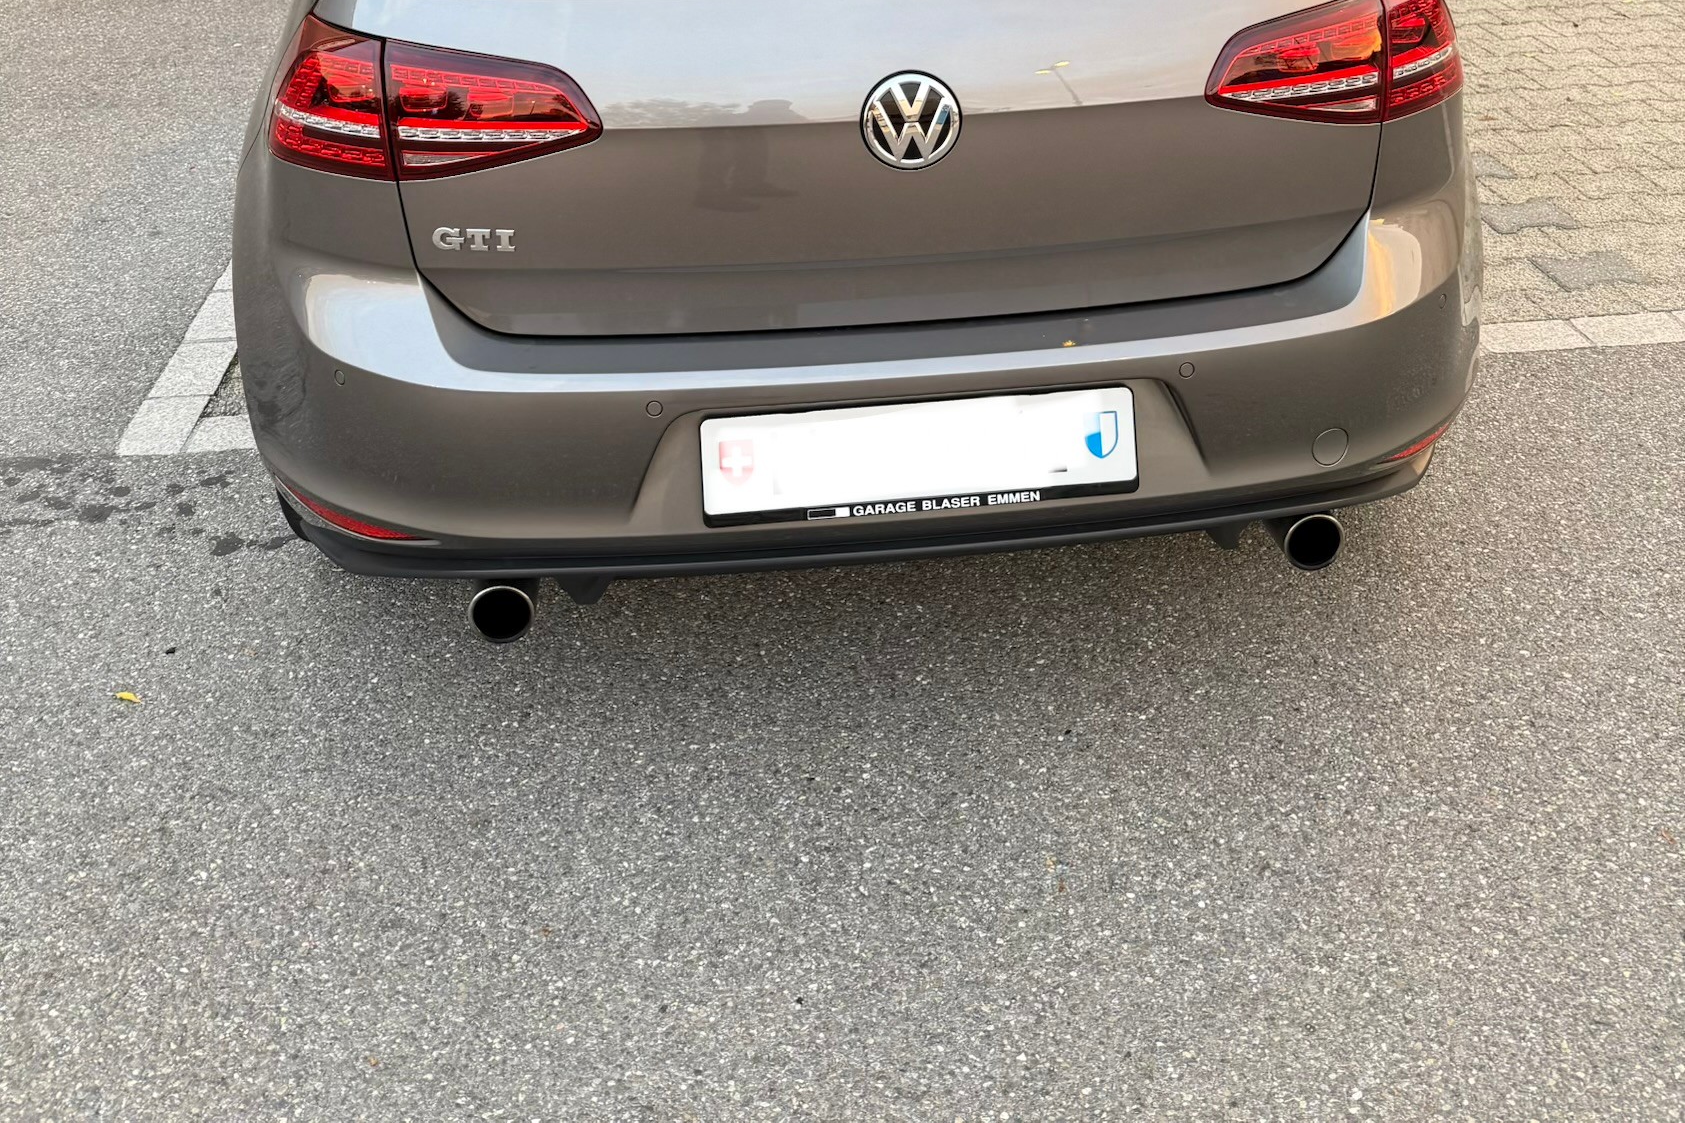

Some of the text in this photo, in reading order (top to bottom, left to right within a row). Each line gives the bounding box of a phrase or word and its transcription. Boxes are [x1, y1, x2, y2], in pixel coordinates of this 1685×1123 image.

[431, 226, 516, 252] GTI
[853, 490, 1041, 517] GARAGE BLASER EMMEN
